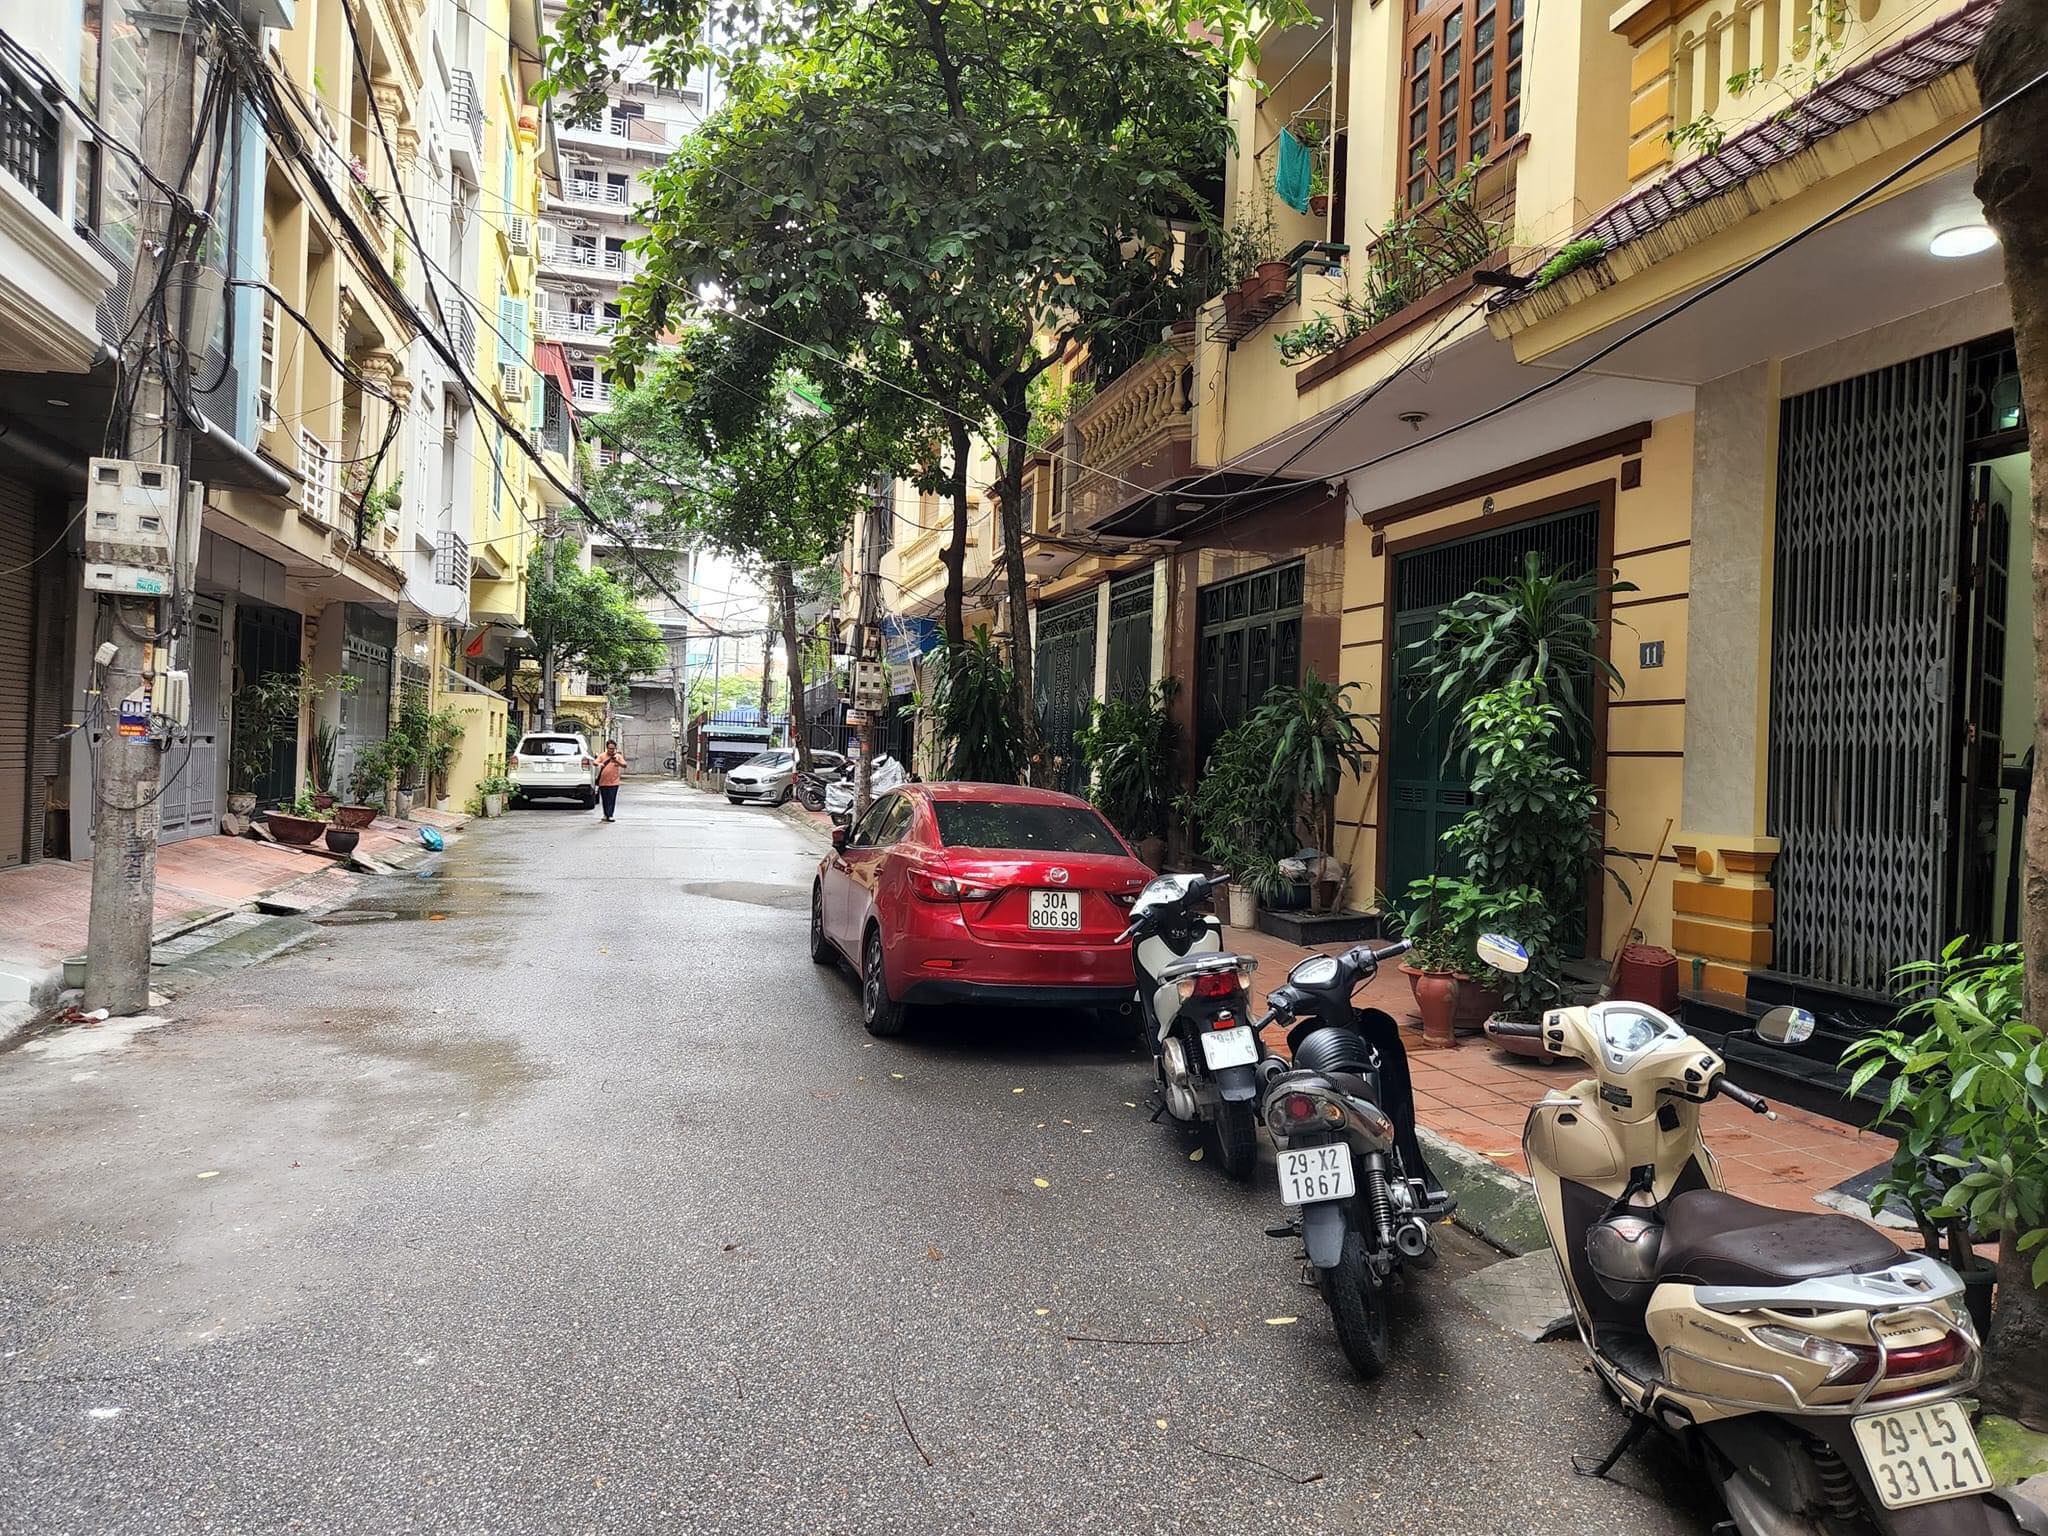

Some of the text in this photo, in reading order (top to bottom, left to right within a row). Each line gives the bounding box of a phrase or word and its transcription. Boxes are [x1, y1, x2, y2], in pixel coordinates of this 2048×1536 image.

[1645, 646, 1657, 665] 11
[1042, 893, 1068, 909] 30A
[1032, 910, 1078, 927] 806.98
[1376, 1117, 1391, 1130] MX
[1288, 1149, 1340, 1176] 29-X2
[1292, 1172, 1342, 1200] 1867
[1881, 1326, 1932, 1338] HONDA
[1871, 1407, 1957, 1457] 29-L5
[1879, 1447, 1984, 1500] 331.21
